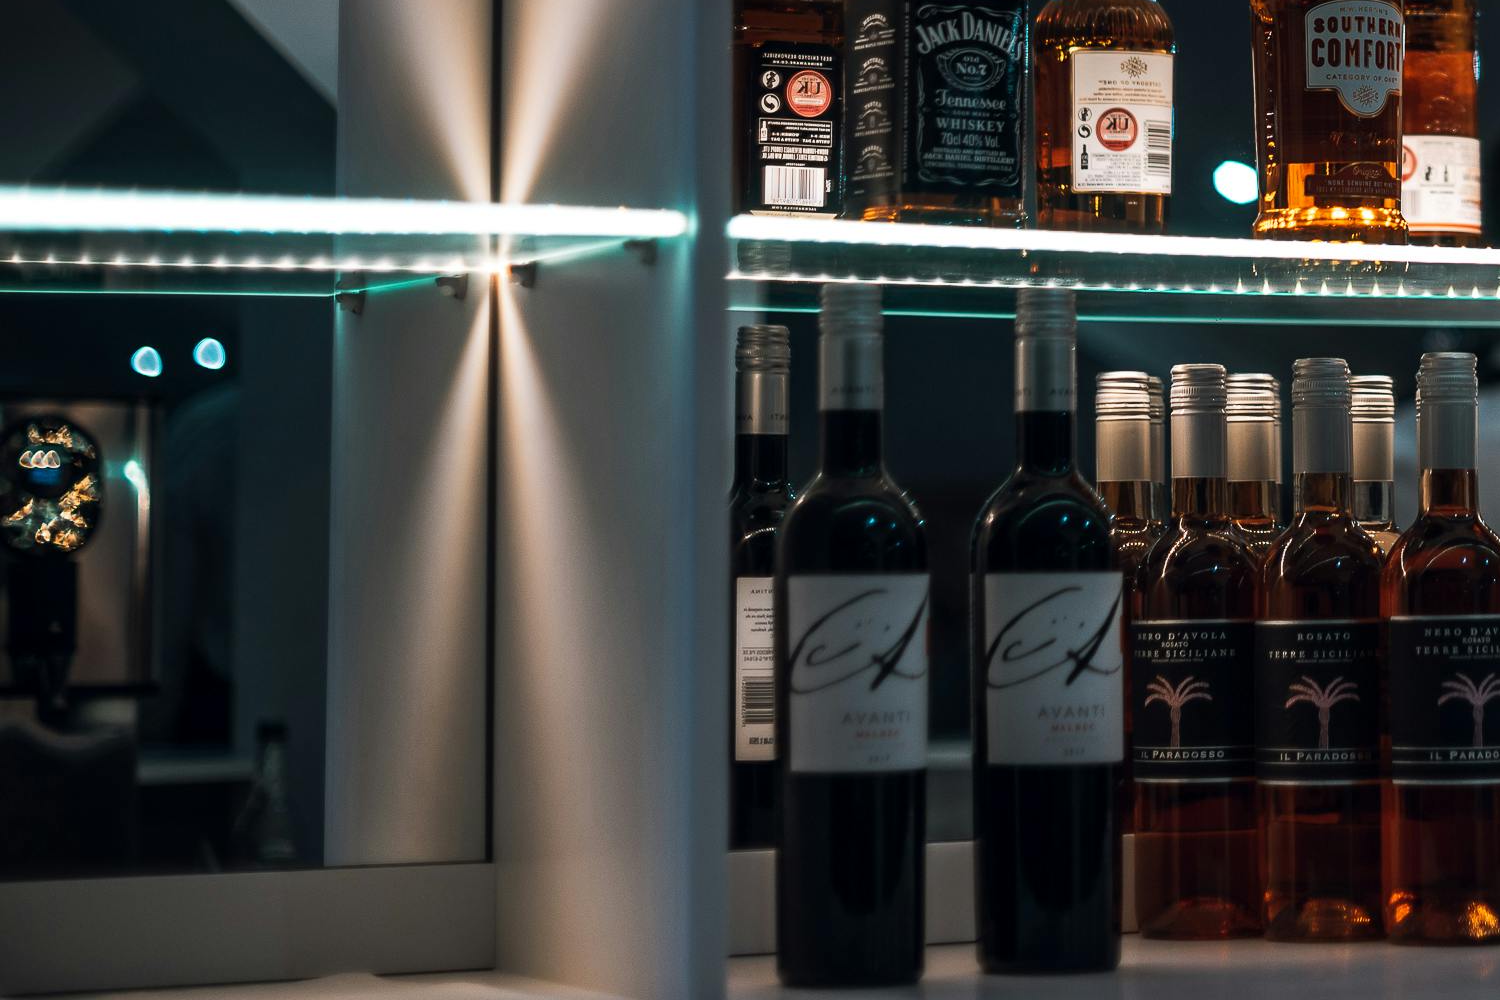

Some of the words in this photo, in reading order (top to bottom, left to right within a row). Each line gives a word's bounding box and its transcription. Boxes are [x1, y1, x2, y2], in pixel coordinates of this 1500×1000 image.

[1313, 16, 1400, 38] SOUTHERN
[915, 18, 960, 55] JACK
[1311, 38, 1401, 73] COMFORT
[956, 62, 988, 75] No.7
[1326, 73, 1370, 81] CATEGORY
[935, 89, 1007, 110] Tennessee
[936, 117, 1005, 133] WHISKEY
[1168, 632, 1226, 640] D'AVOLA
[1297, 632, 1351, 641] ROSATO
[1424, 628, 1462, 637] NERO
[1166, 649, 1236, 658] SICILIANE
[1269, 650, 1305, 659] TERRE
[1415, 646, 1459, 655] TERRE
[1038, 704, 1105, 719] AVANTI
[1280, 752, 1291, 761] IL
[1430, 751, 1442, 760] IL
